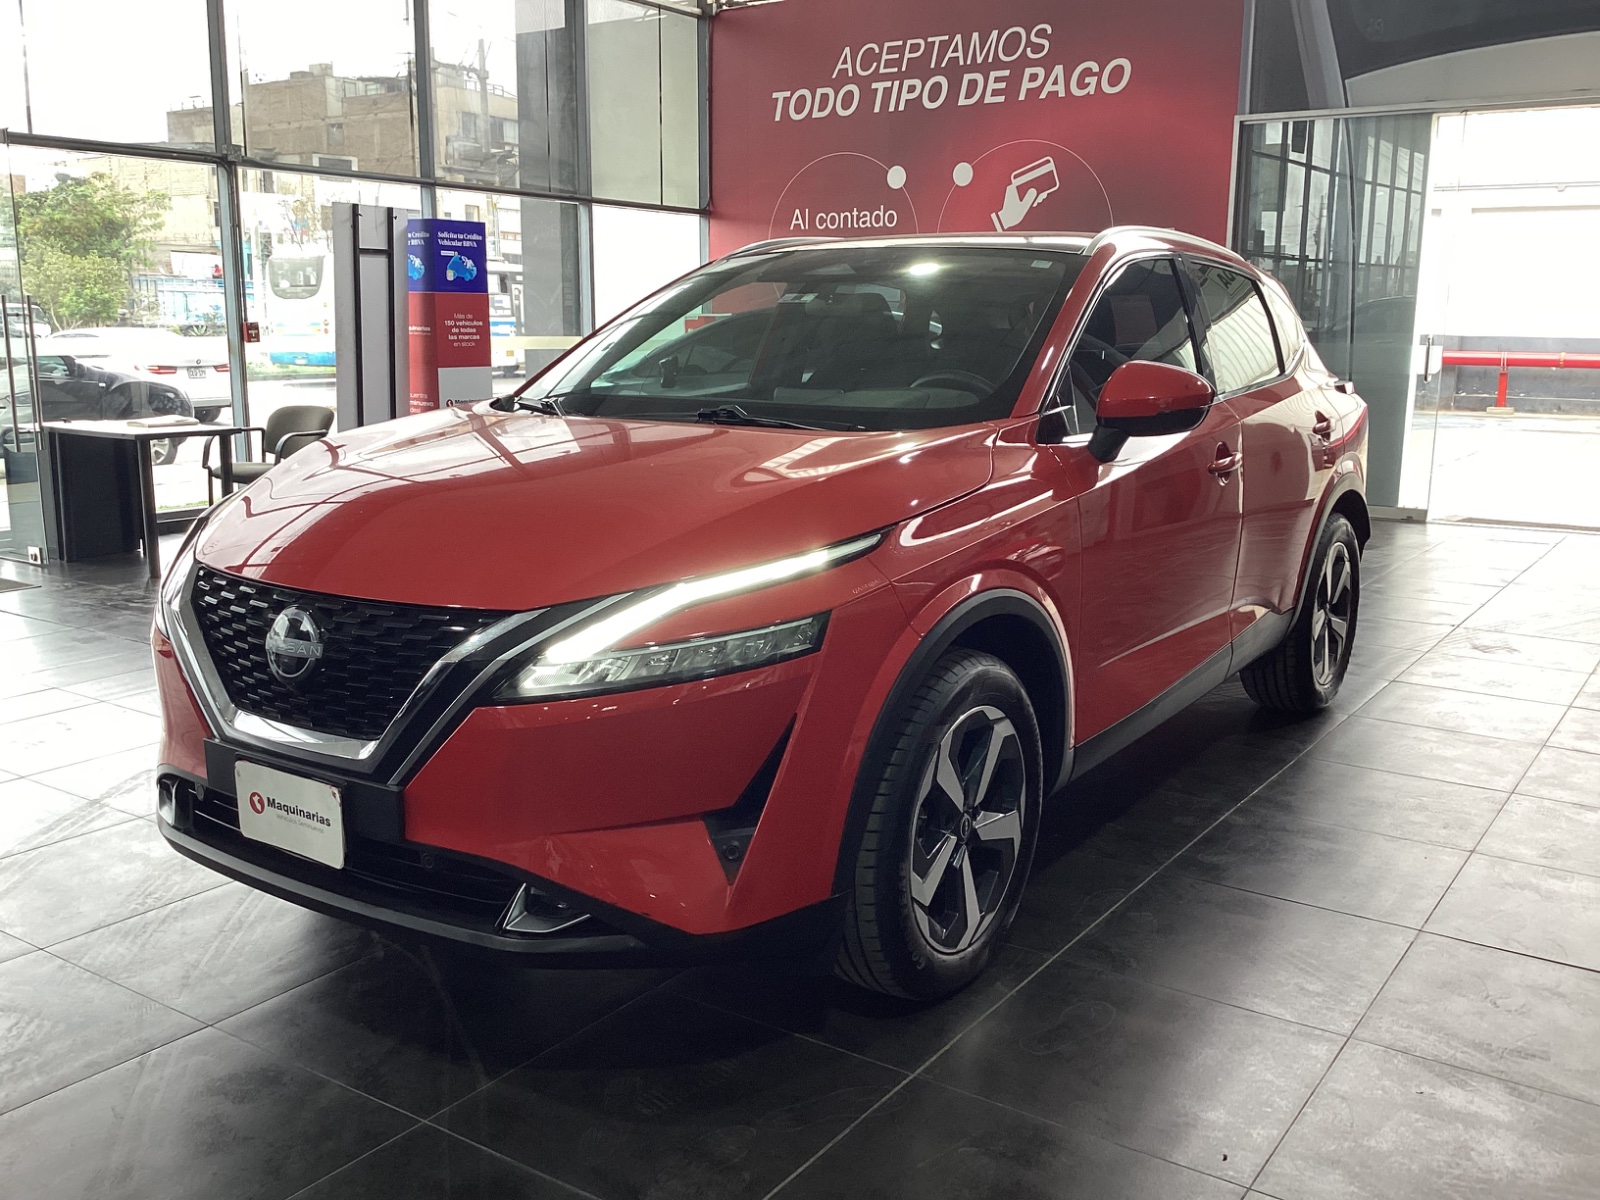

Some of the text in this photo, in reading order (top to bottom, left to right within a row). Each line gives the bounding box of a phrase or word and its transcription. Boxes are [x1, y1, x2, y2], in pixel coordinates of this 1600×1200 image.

[832, 23, 1053, 78] ACEPTAMOS
[771, 57, 1132, 121] TODO TIPO DE PAGO
[790, 205, 897, 230] Al contado
[437, 231, 458, 239] Solicita
[437, 238, 478, 248] Vehicular BBVA
[266, 796, 331, 827] Maquinarias
